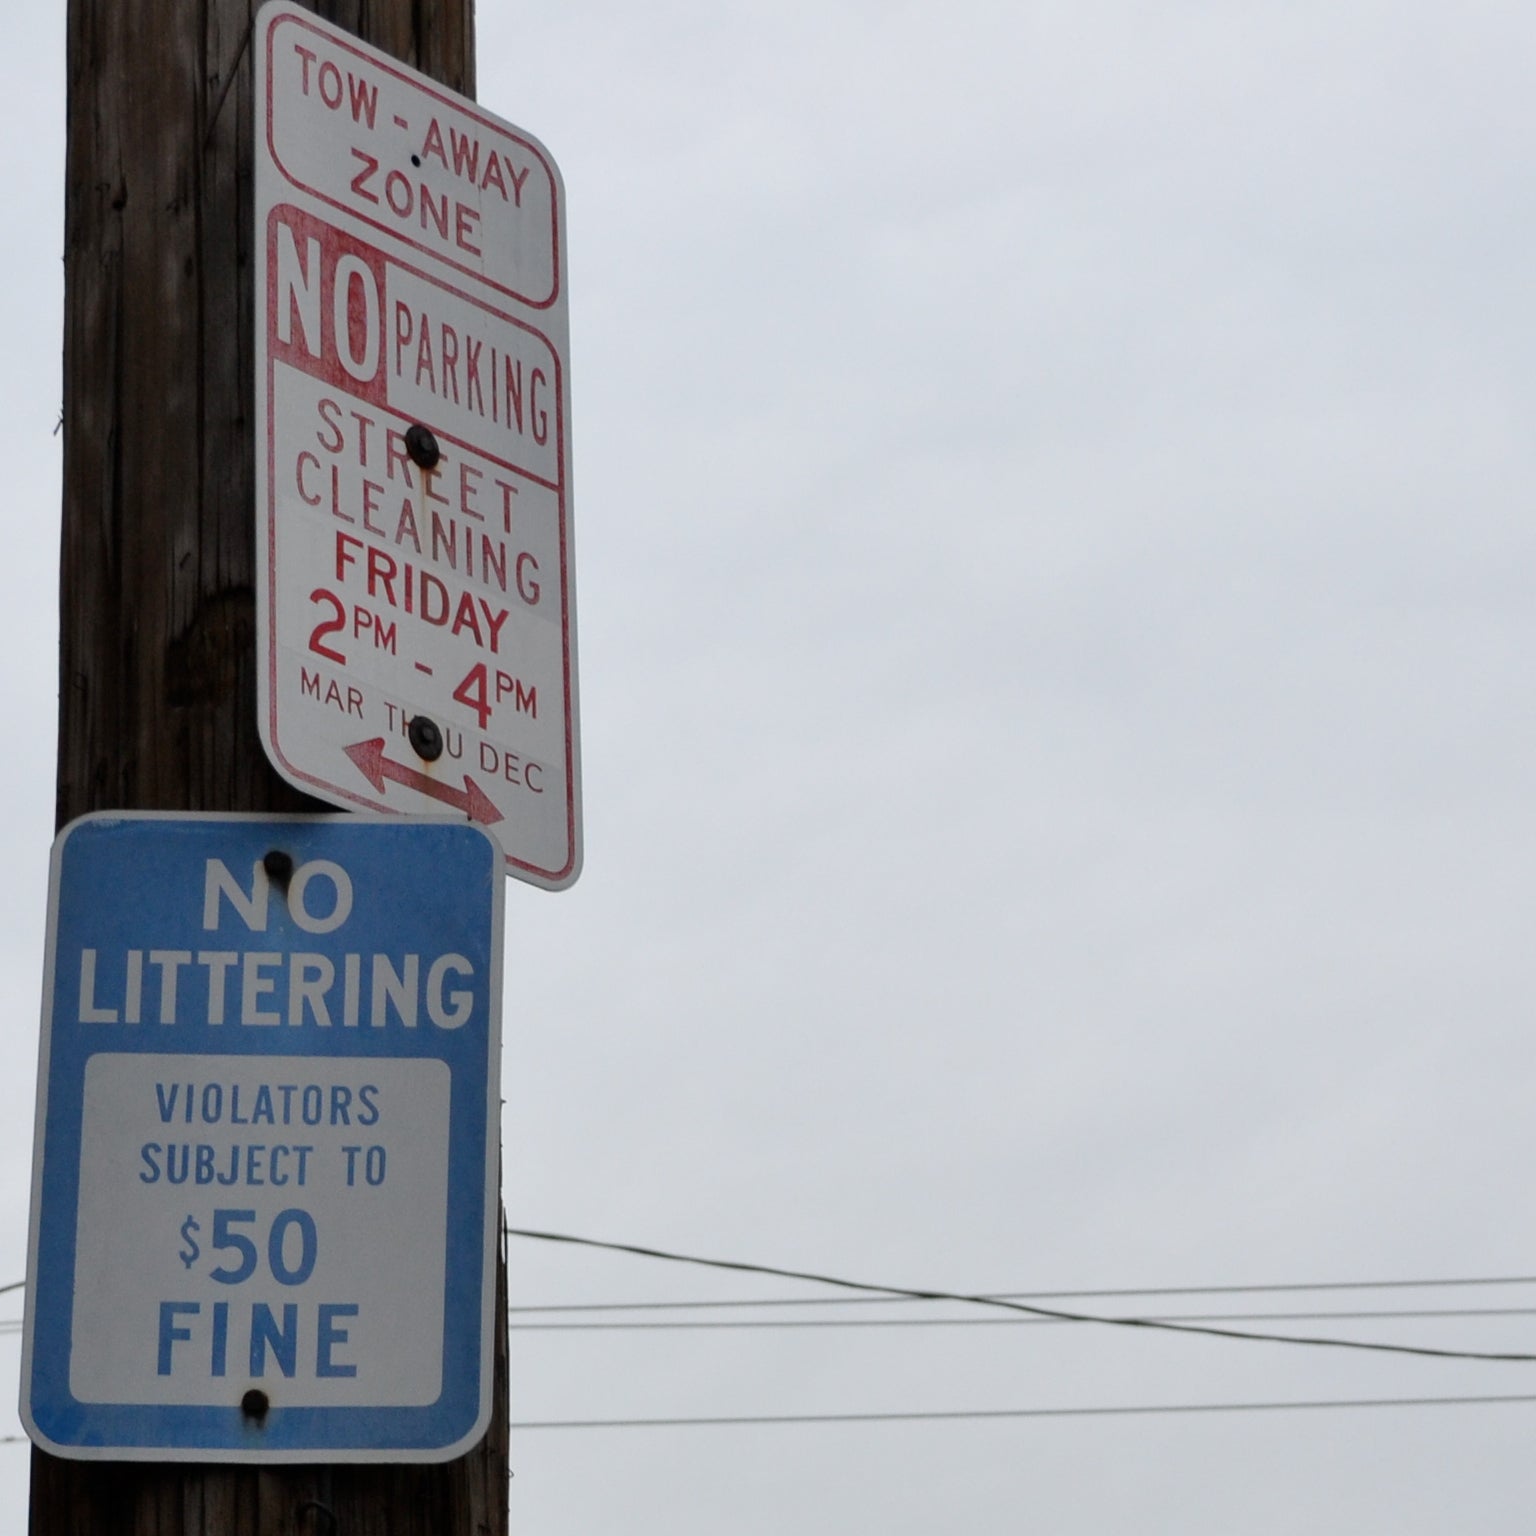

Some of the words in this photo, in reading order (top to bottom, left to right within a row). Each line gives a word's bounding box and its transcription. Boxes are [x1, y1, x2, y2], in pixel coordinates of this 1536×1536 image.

[350, 146, 482, 258] ZONE
[276, 220, 381, 384] NO
[395, 299, 548, 446] PARKING
[295, 450, 541, 606] CLEANING
[335, 530, 510, 654] FRIDAY
[300, 666, 364, 720] MAR
[383, 701, 463, 760] THU
[479, 740, 544, 793] DEC
[202, 857, 354, 935] NO
[77, 947, 476, 1031] LITTERING
[154, 1081, 381, 1127] VIOLATORS
[138, 1142, 314, 1187] SUBJECT
[340, 1145, 388, 1187] TO
[178, 1207, 319, 1286] $50
[155, 1299, 361, 1380] FINE
